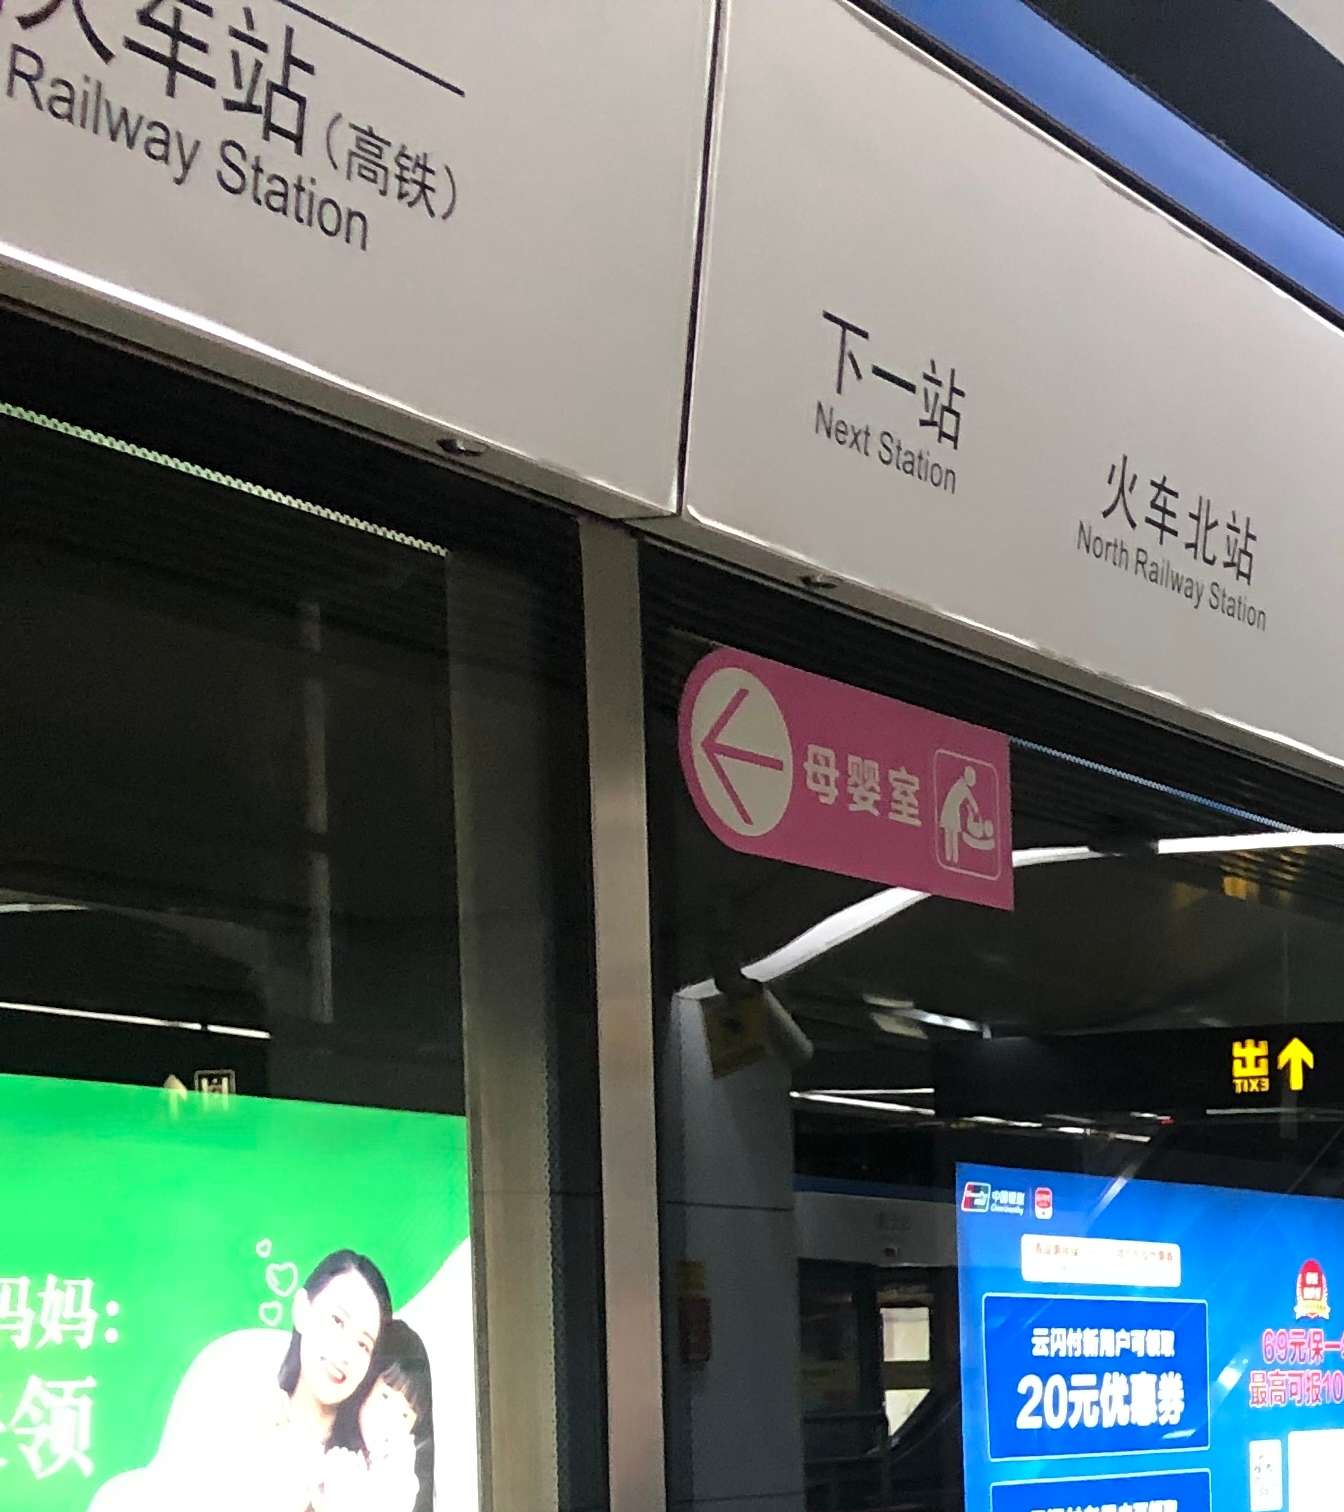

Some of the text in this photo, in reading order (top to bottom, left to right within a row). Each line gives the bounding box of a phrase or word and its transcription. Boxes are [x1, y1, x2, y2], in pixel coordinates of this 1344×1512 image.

[7, 43, 370, 252] Railway Station
[822, 309, 966, 450] 下一站
[814, 401, 957, 494] Next Station
[1101, 454, 1258, 587] 火车北站
[1076, 519, 1268, 632] North Railway Station
[803, 743, 922, 828] 母婴室
[0, 1374, 98, 1480] 领
[1016, 1372, 1185, 1430] 20元优惠券
